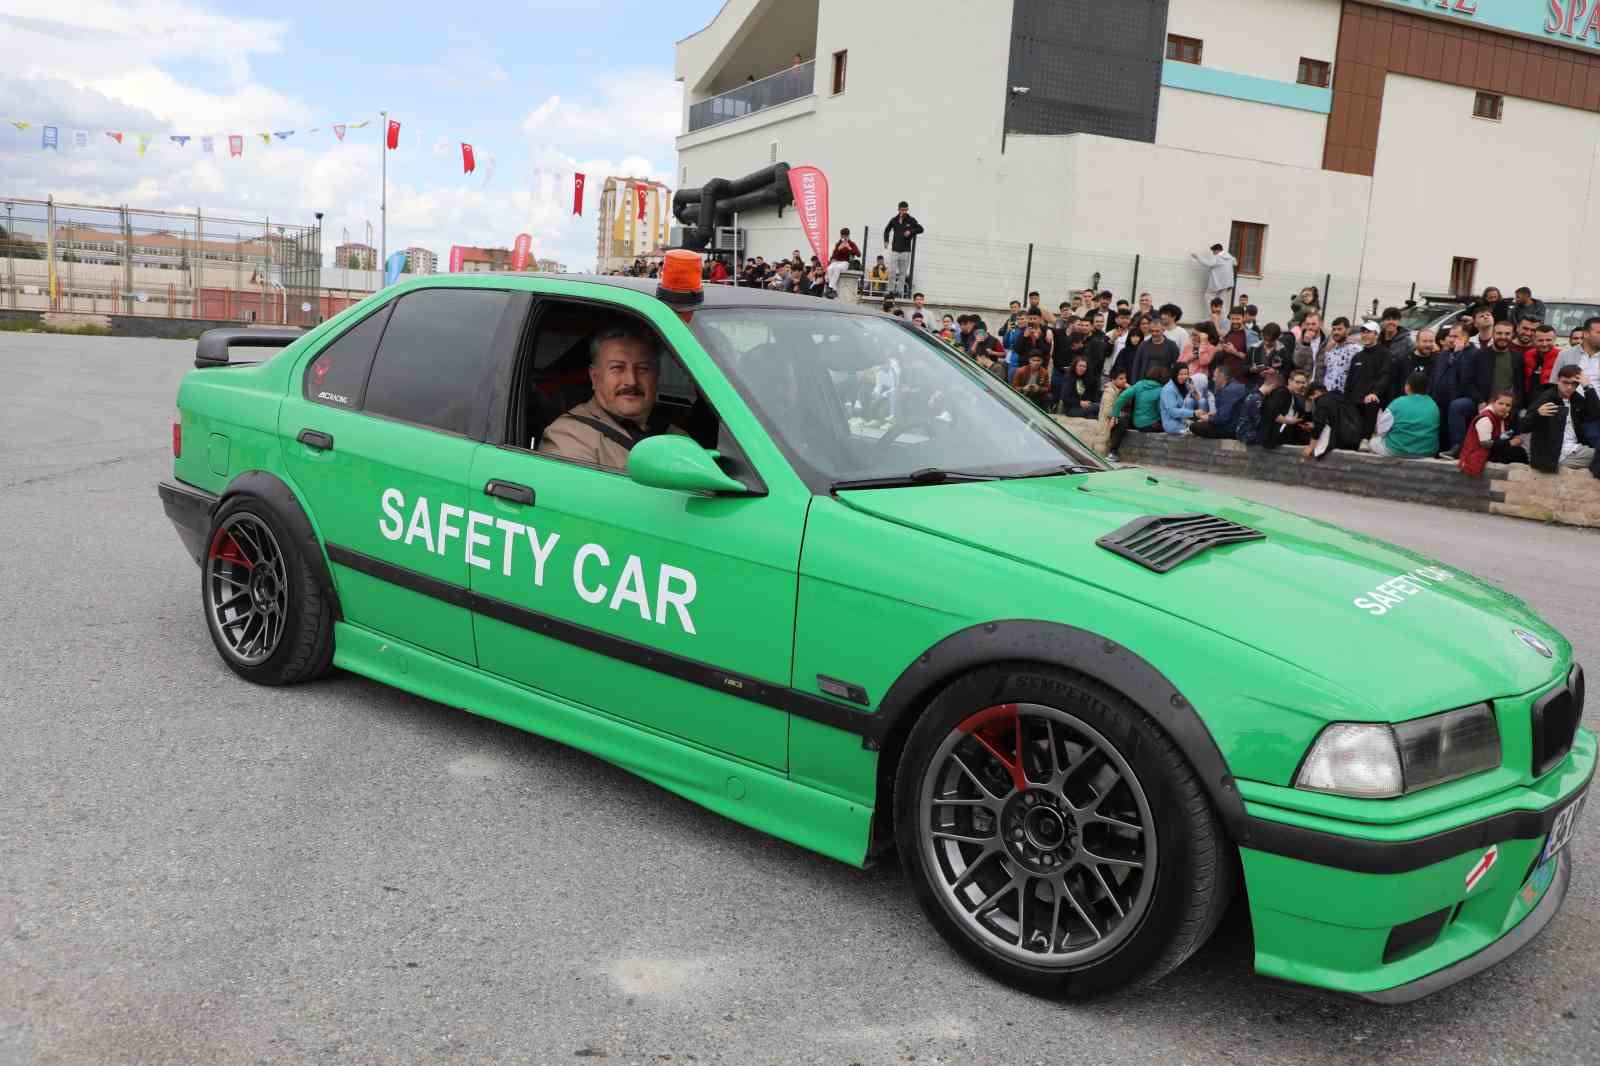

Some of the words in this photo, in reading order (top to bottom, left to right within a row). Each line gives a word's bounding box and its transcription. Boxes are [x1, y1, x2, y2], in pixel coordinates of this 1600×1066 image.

[379, 487, 561, 587] SAFETY
[573, 543, 697, 635] CAR
[1353, 572, 1432, 615] SAFETY
